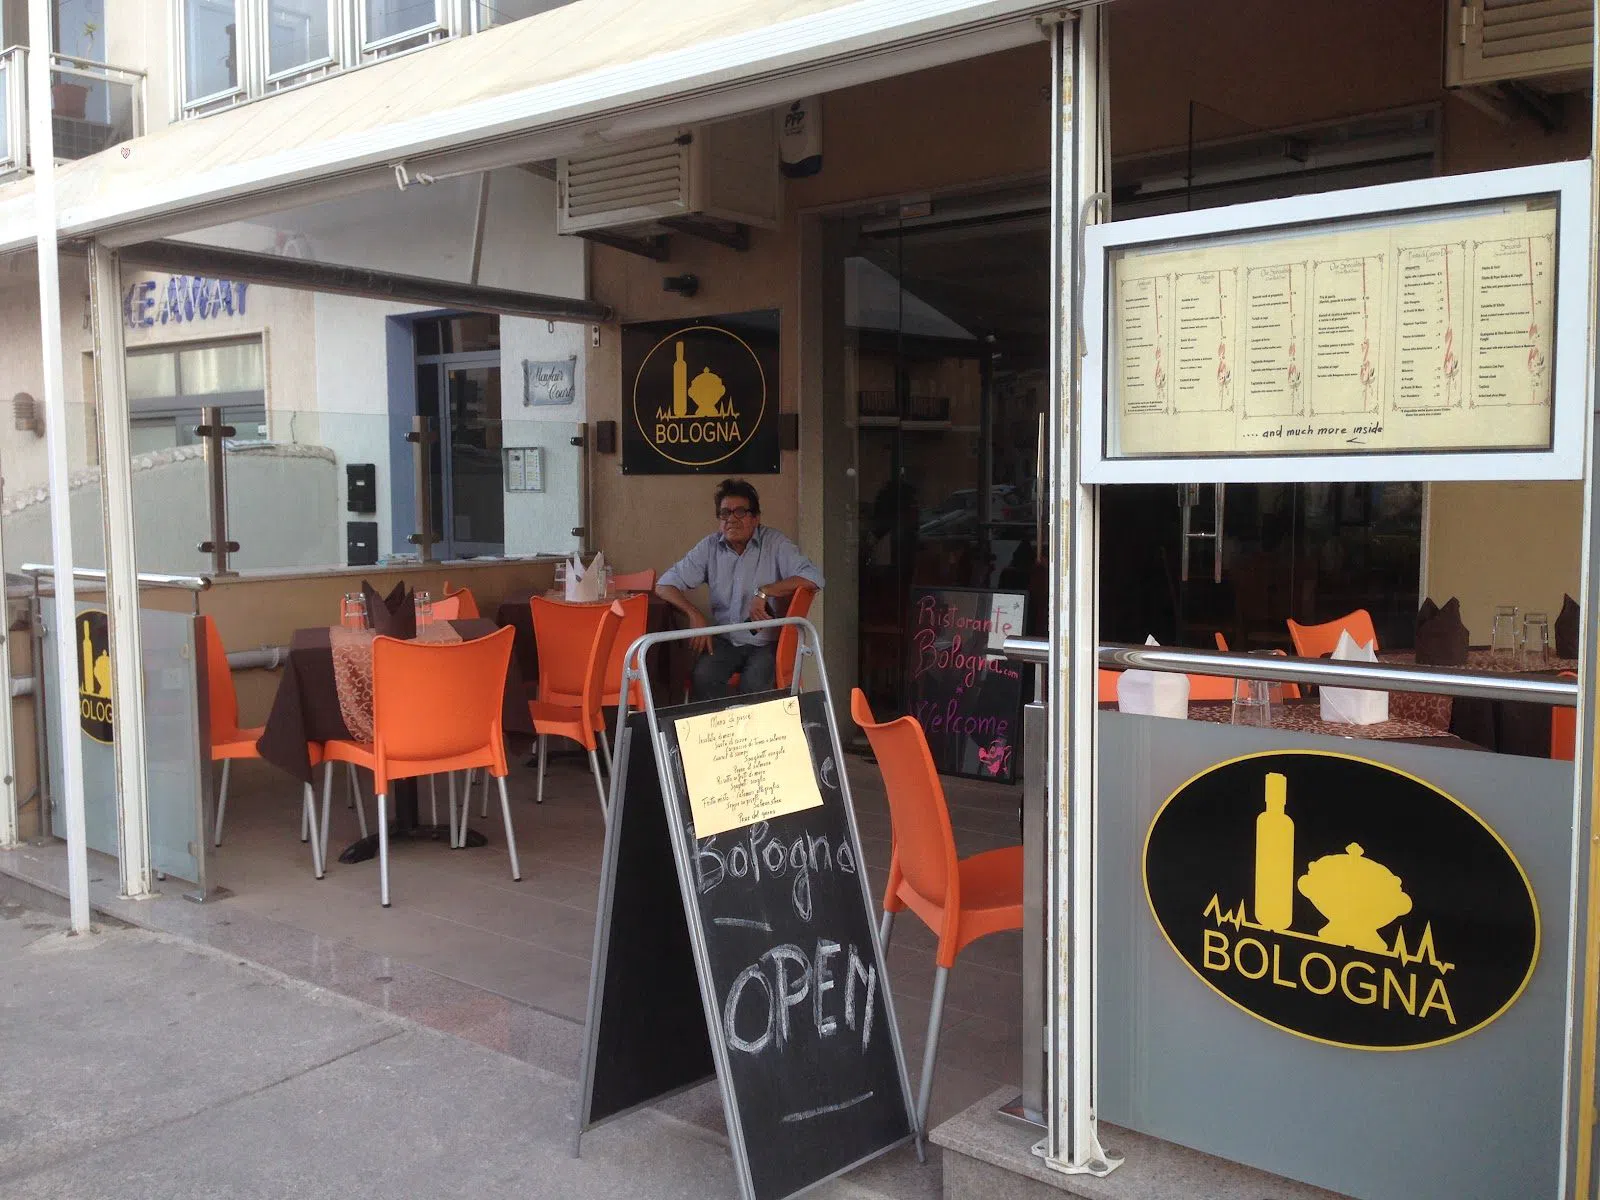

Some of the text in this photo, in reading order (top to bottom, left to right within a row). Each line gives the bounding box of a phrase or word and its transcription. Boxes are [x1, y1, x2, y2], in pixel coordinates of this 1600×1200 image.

[549, 383, 574, 400] Court
[656, 421, 741, 444] BOLOGNA
[1262, 425, 1283, 437] and
[1286, 425, 1314, 436] much
[1317, 427, 1347, 436] more
[1353, 421, 1383, 435] inside
[918, 595, 1012, 636] Ristorante
[79, 698, 113, 724] OLOG
[908, 699, 1008, 736] Welcome
[690, 820, 856, 922] Bologna
[724, 937, 877, 1054] OPEN
[1203, 929, 1457, 1025] BOLOGNA
